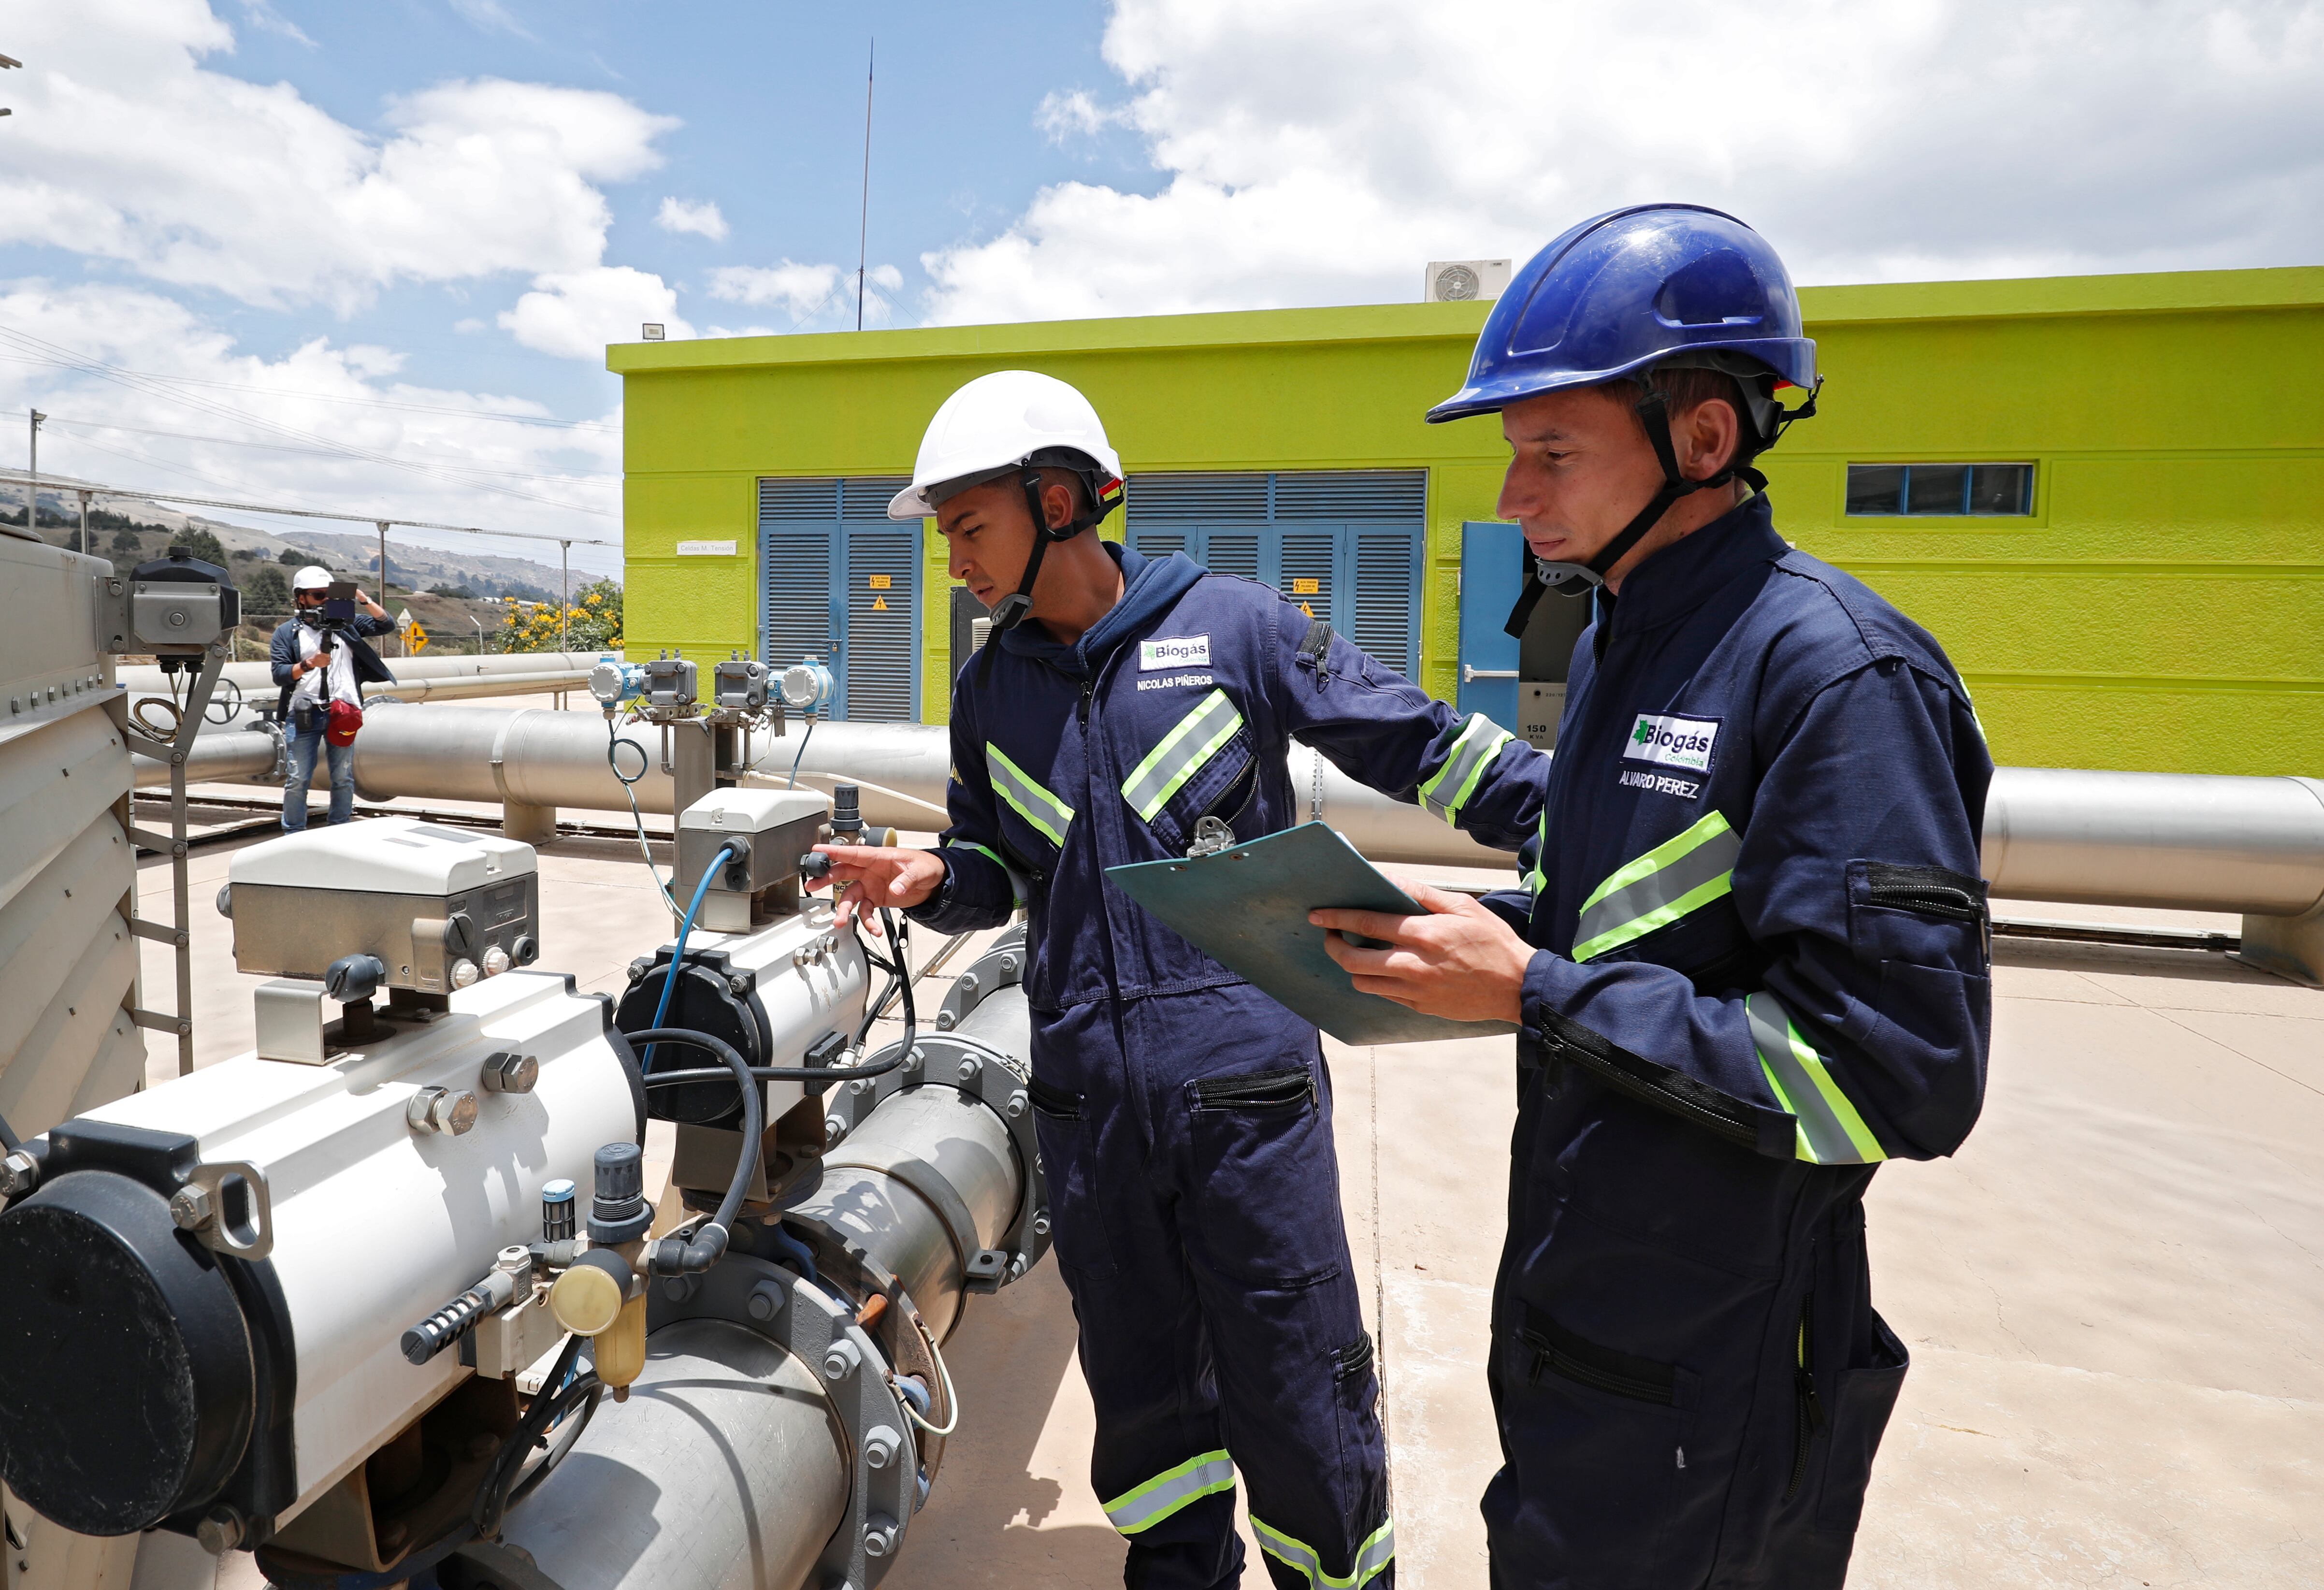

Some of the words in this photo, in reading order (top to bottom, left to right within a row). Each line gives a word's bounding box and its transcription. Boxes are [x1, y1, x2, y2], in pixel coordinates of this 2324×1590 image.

[1155, 643, 1206, 658] Biogás
[1137, 679, 1174, 691] NICOLAS
[1175, 674, 1213, 686] PIÑEROS
[1527, 724, 1547, 733] 150
[1643, 725, 1709, 753] Biogás
[1665, 753, 1704, 768] Colombia
[1619, 770, 1656, 789] ALVARO
[1655, 776, 1700, 799] PEREZ
